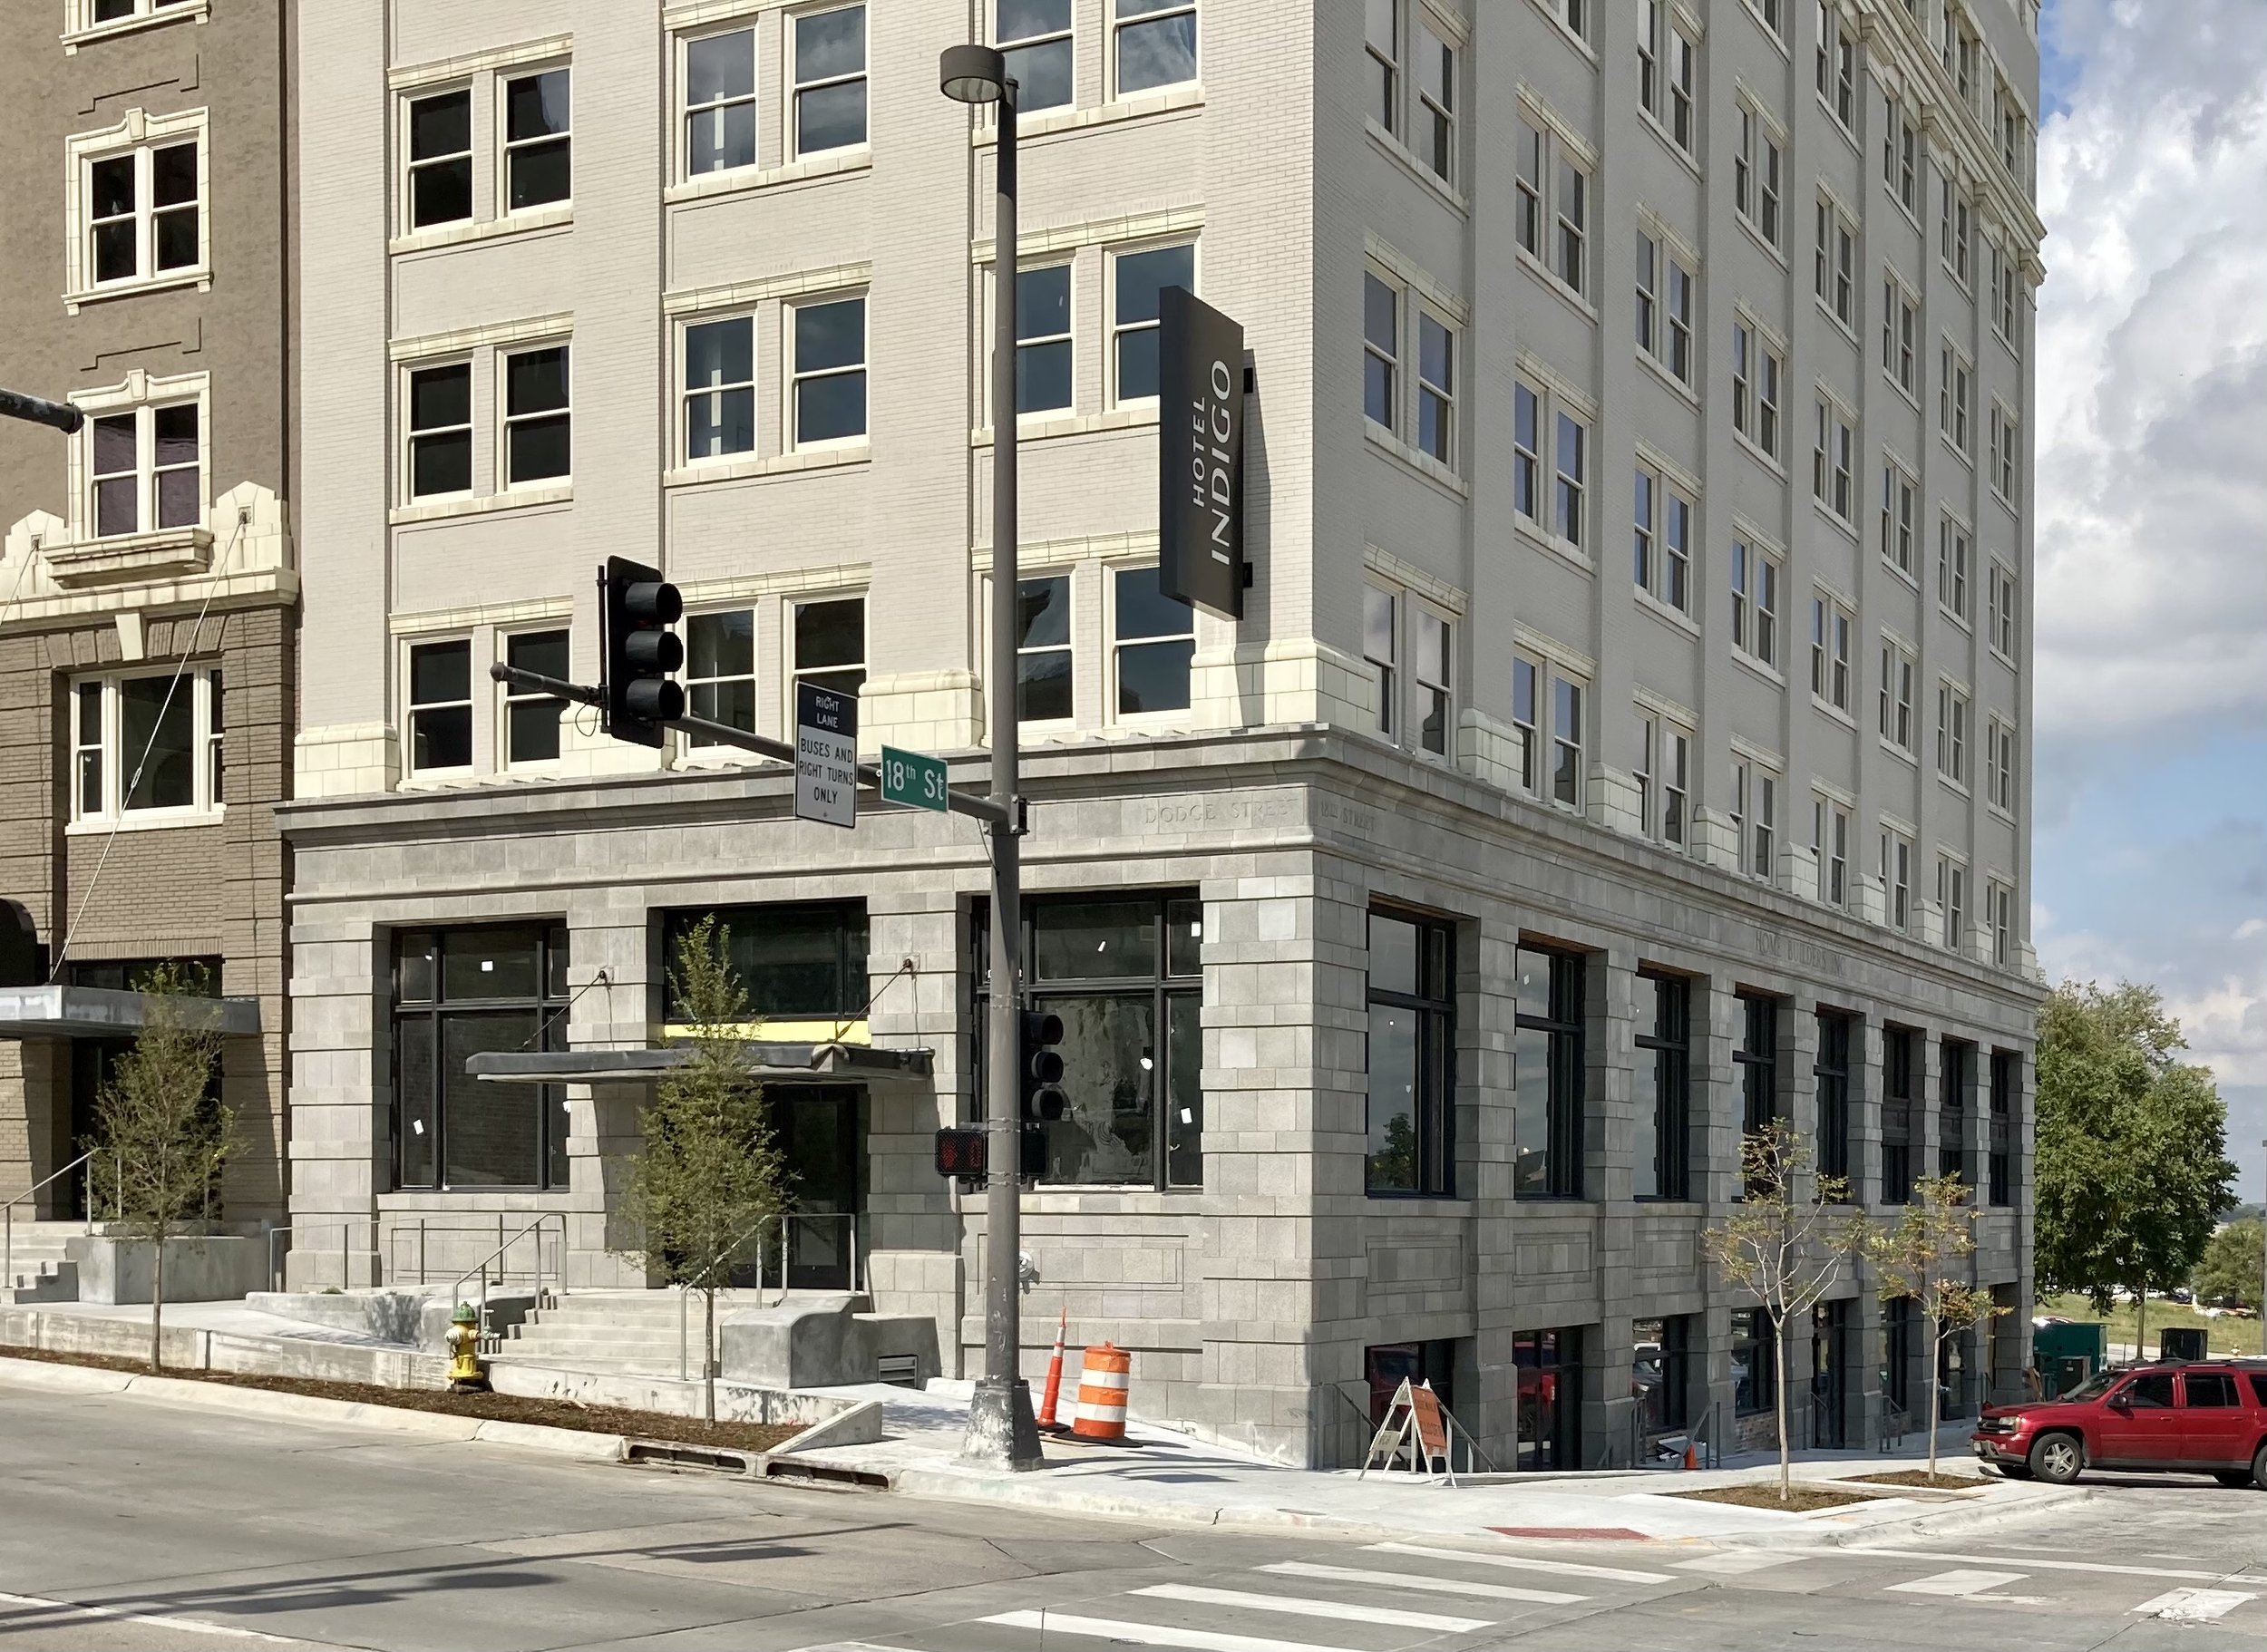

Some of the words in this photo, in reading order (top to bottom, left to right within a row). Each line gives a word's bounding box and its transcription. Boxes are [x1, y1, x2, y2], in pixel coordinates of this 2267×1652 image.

[1192, 396, 1206, 508] HOTEL
[1211, 359, 1231, 566] INDIGO
[815, 695, 840, 713] RIGHT
[817, 713, 839, 729] LANE
[801, 738, 831, 759] BUSES
[834, 746, 853, 763] AND
[799, 760, 824, 780] RIGHT
[827, 766, 854, 786] TURNS
[886, 759, 917, 792] 18th
[924, 769, 945, 802] St
[813, 786, 838, 805] ONLY
[1145, 804, 1217, 824] DODGE
[1756, 930, 1782, 957] HOME
[1787, 939, 1827, 971] BUILDERS
